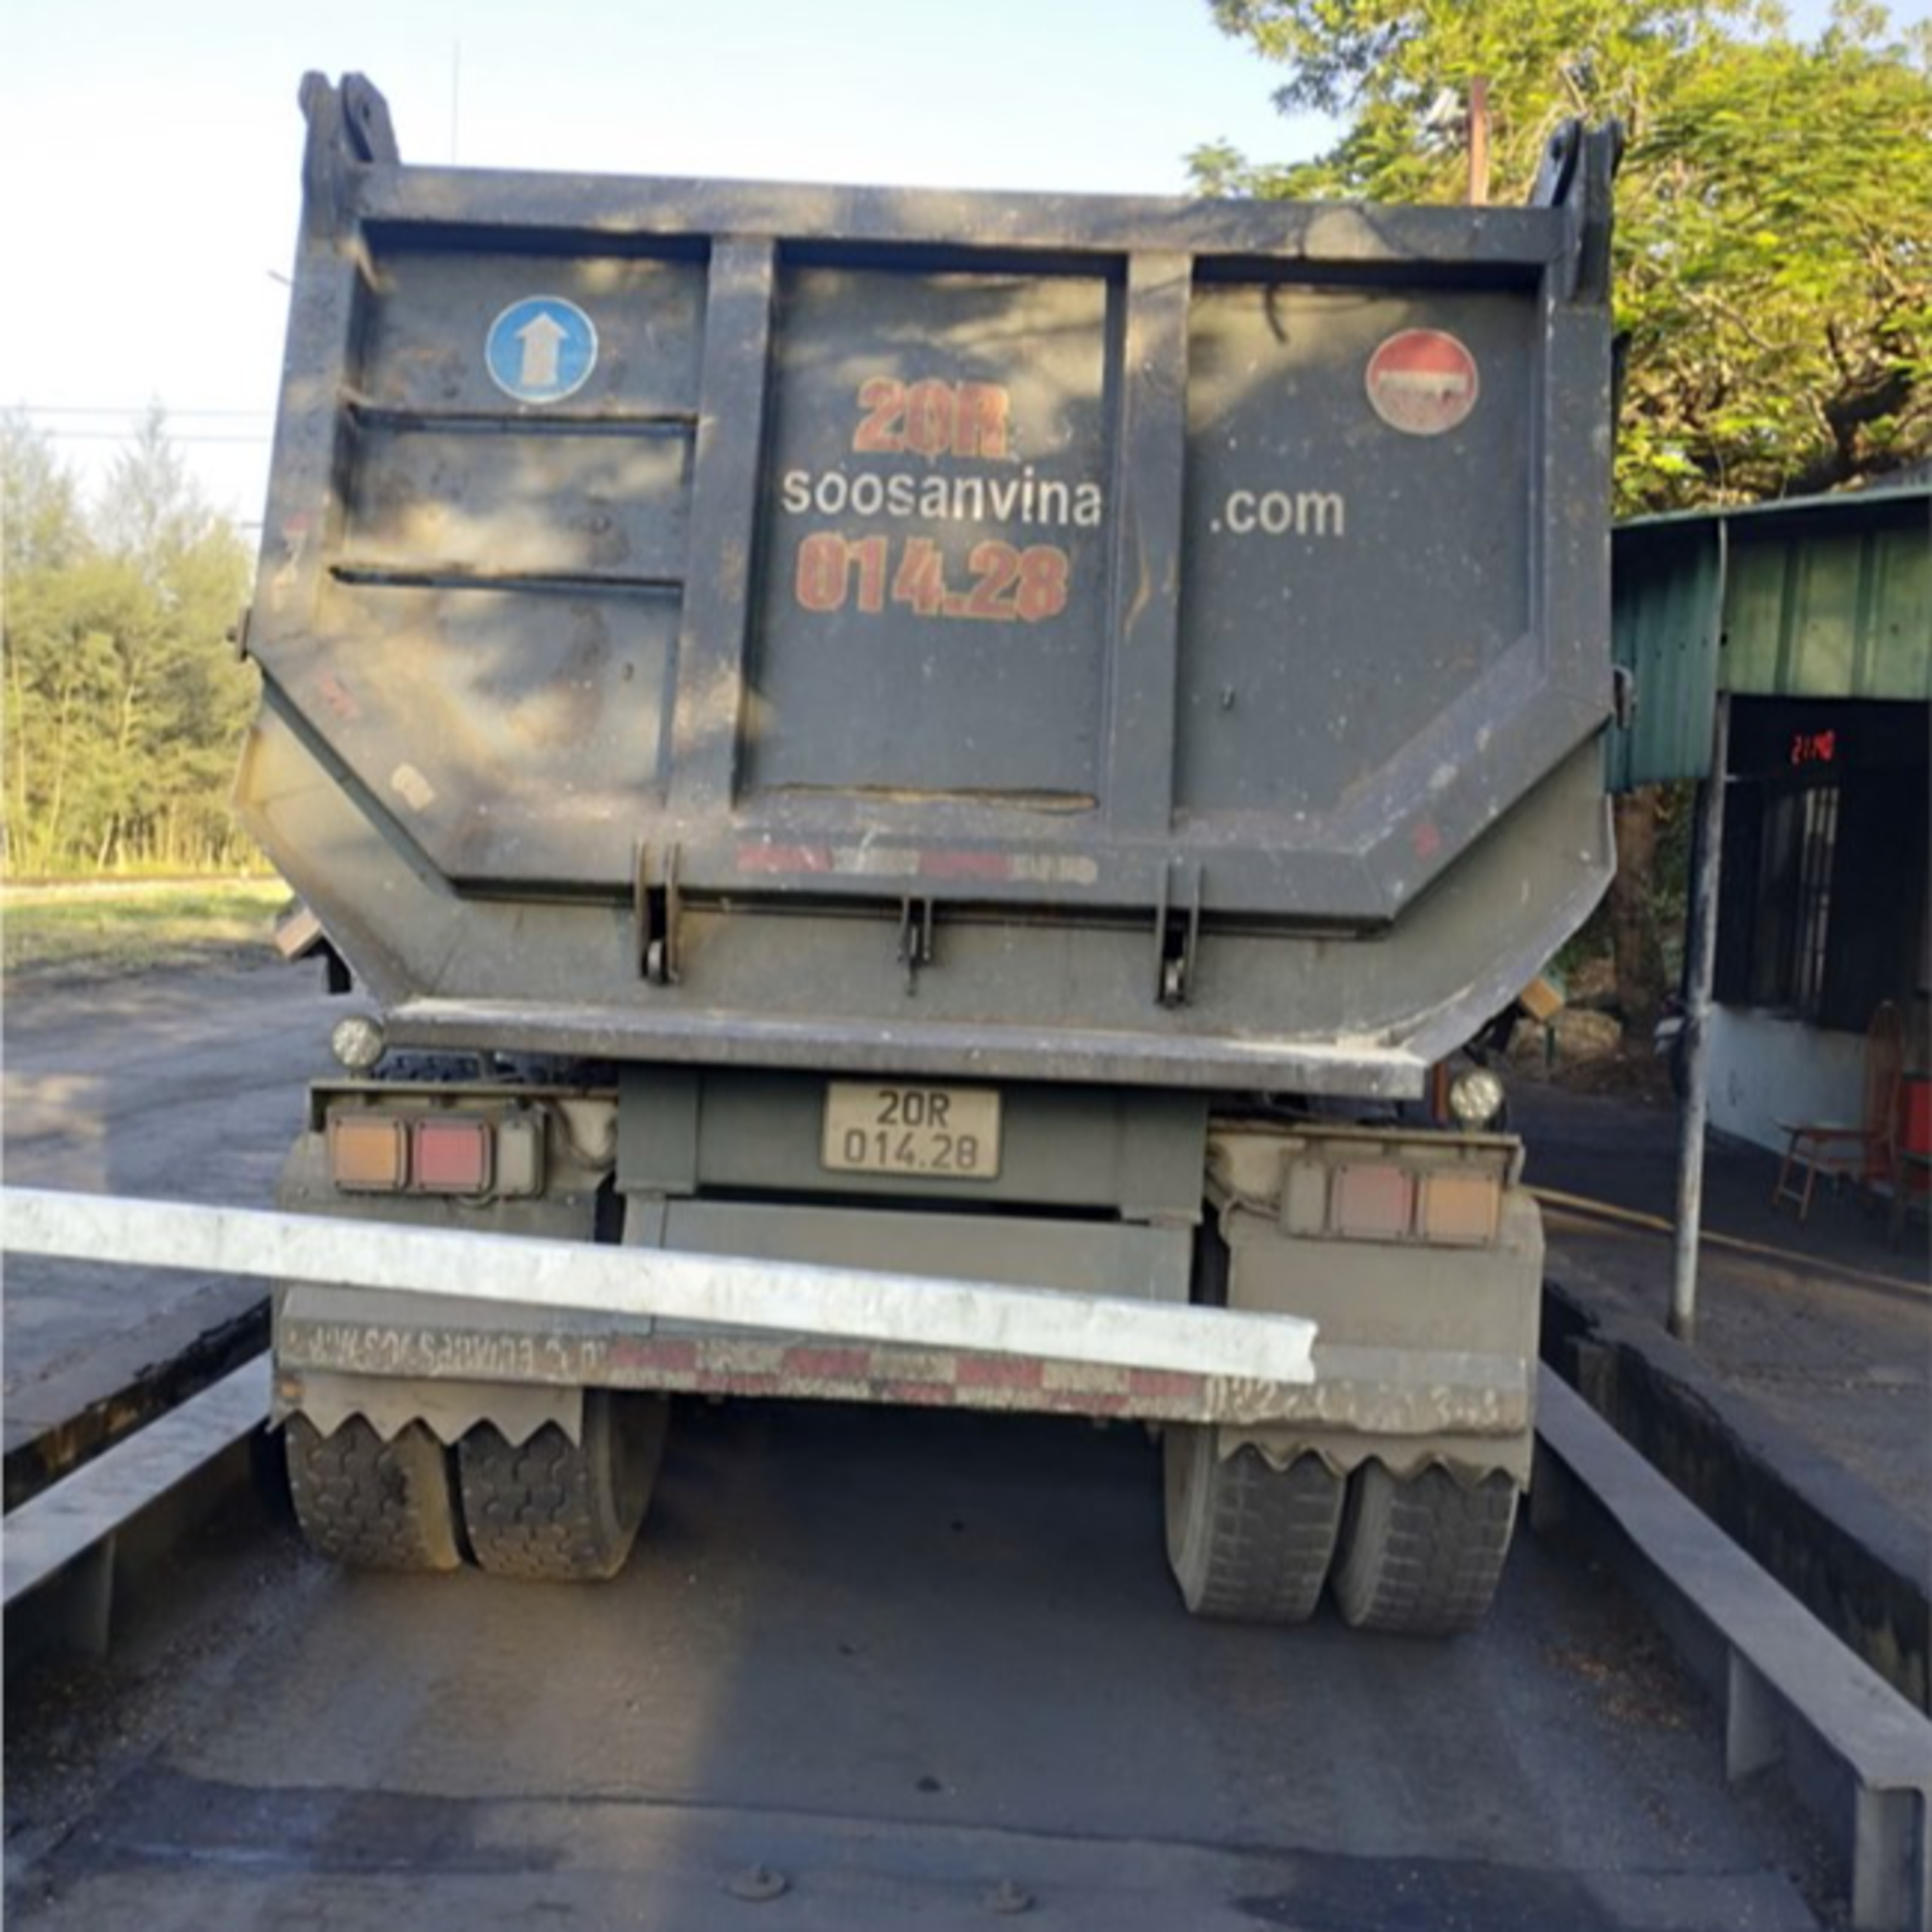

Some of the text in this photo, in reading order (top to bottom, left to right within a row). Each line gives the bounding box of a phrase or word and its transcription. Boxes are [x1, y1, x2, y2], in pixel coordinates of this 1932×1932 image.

[852, 377, 1010, 459] 20R
[782, 467, 1345, 536] soosanvina .com
[795, 531, 1070, 623] 014.28
[876, 1089, 950, 1128] 20R
[843, 1128, 978, 1170] 014.28
